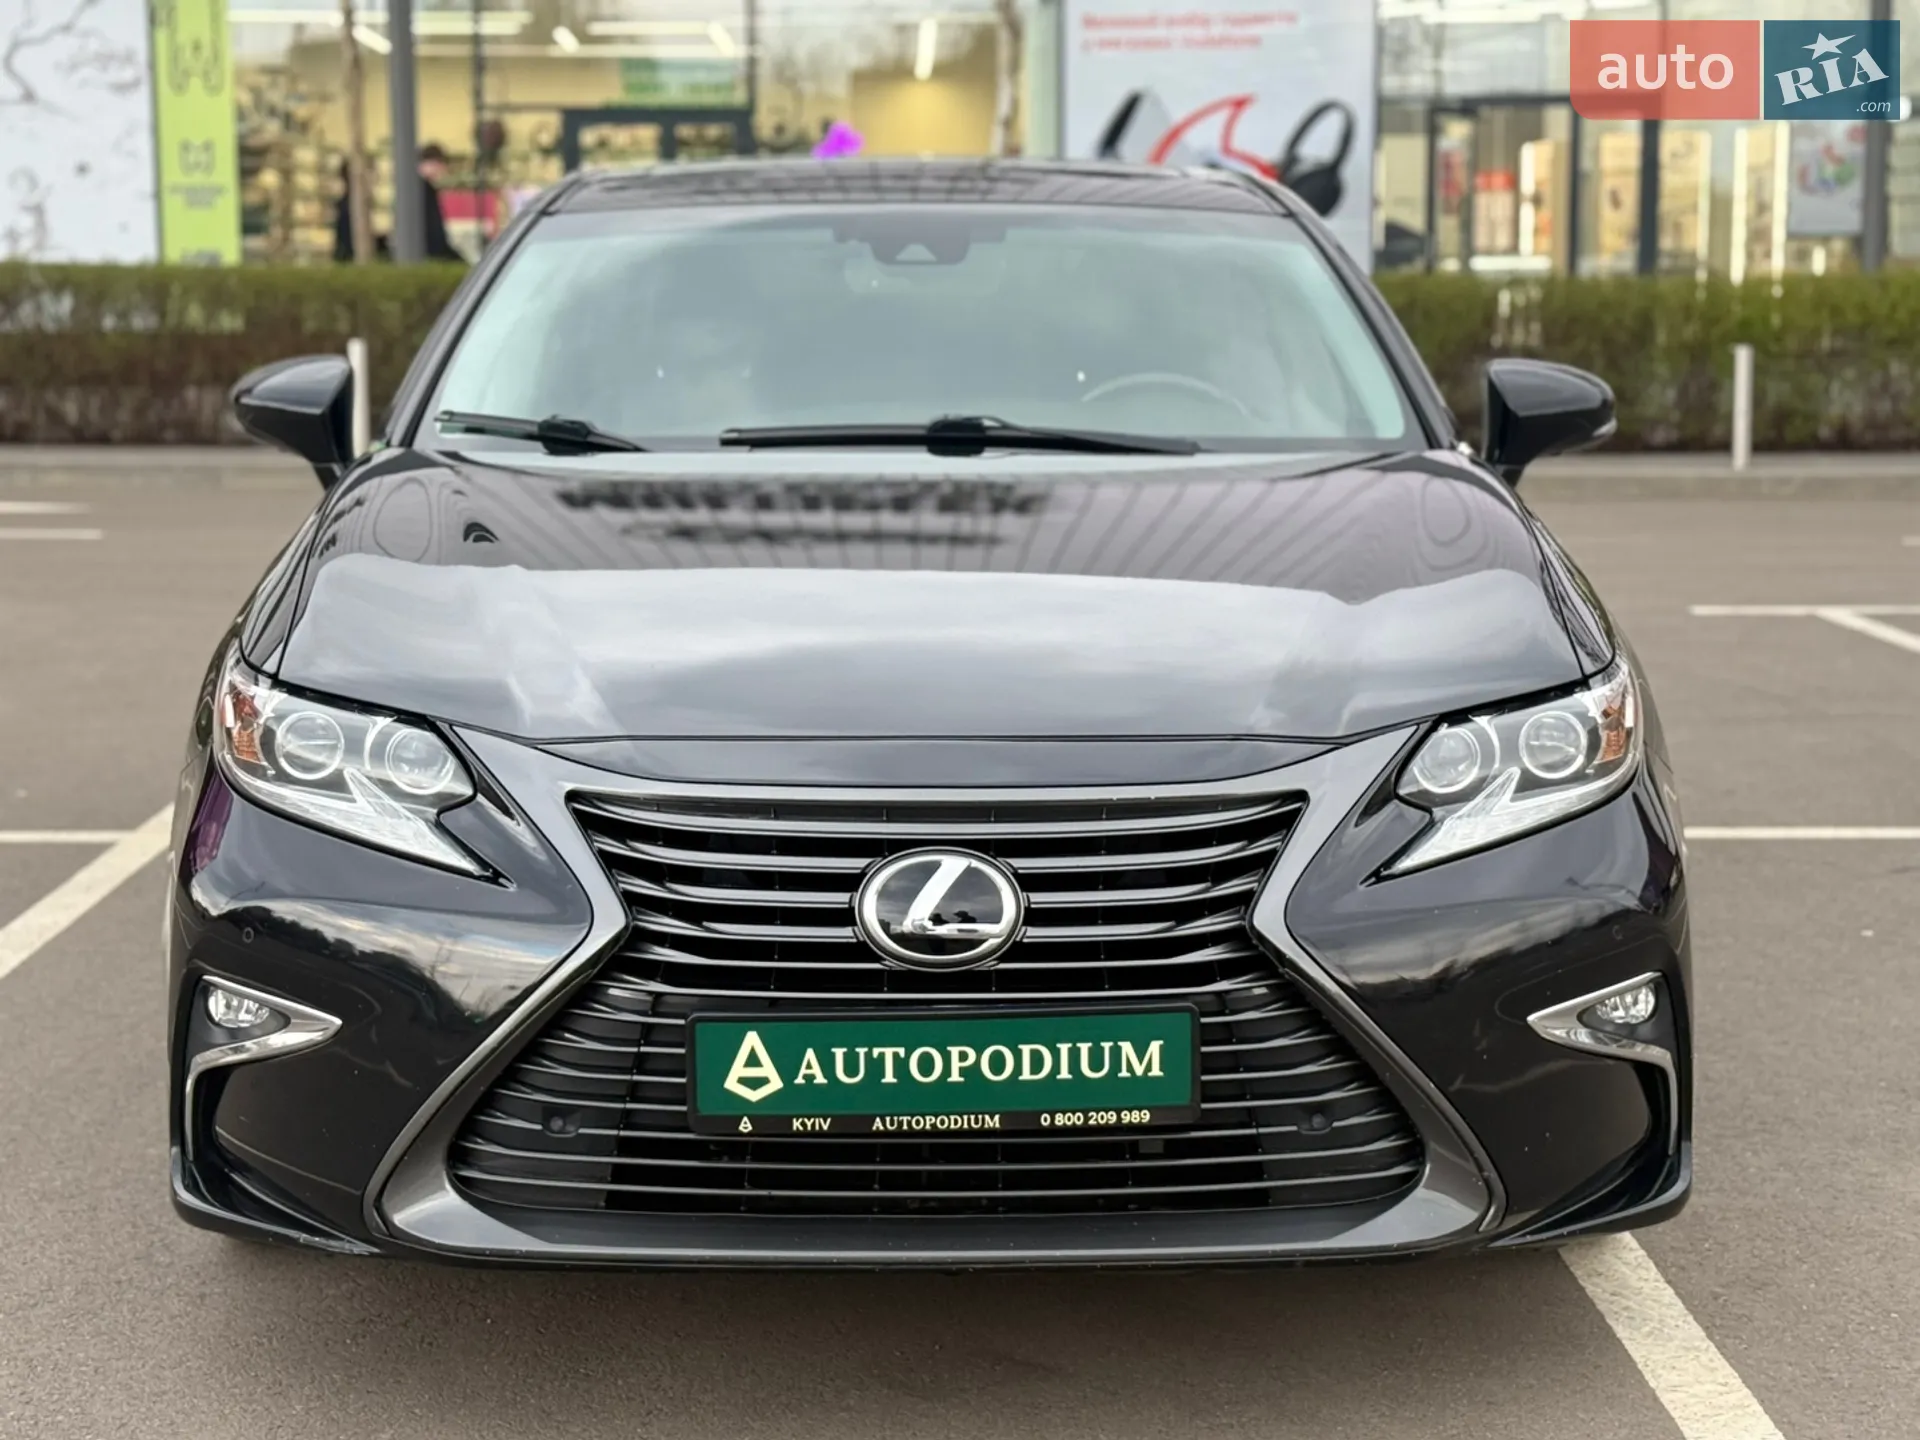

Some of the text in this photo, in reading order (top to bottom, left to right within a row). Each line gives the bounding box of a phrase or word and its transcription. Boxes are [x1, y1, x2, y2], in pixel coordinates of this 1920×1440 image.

[793, 1039, 1164, 1085] AUTOPODIUM
[792, 1117, 831, 1131] KYIV
[872, 1114, 1001, 1131] AUTOPODIUM
[1040, 1109, 1151, 1126] 0 800 209 989
